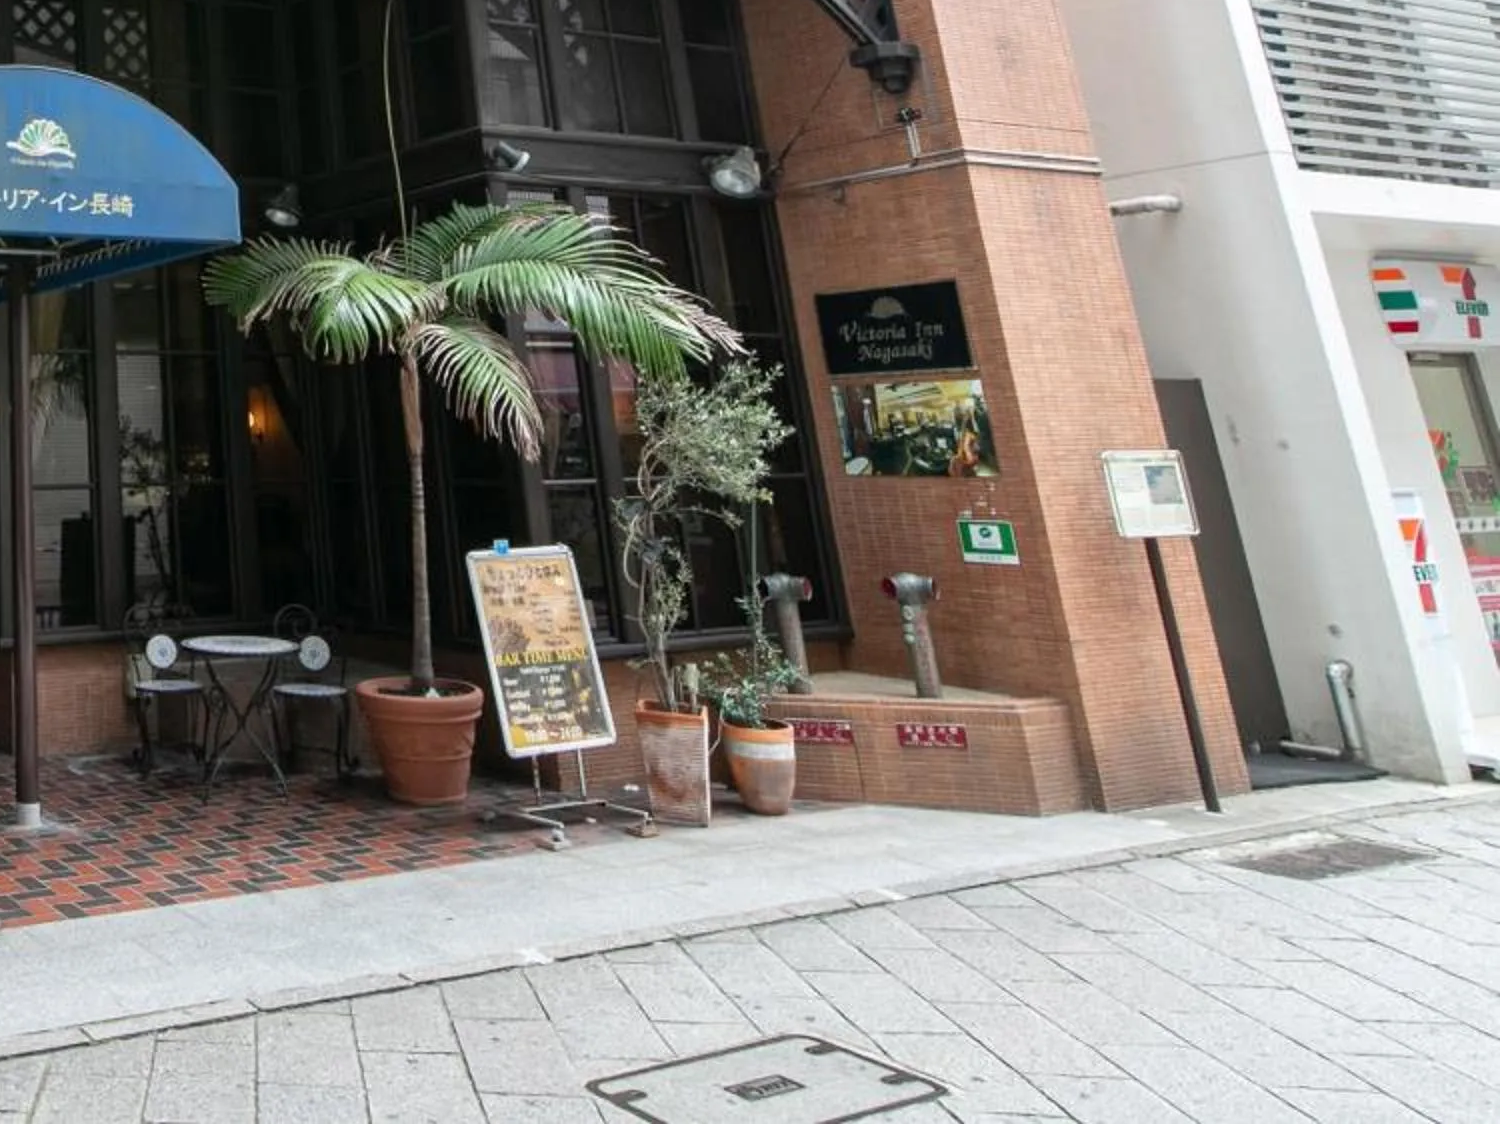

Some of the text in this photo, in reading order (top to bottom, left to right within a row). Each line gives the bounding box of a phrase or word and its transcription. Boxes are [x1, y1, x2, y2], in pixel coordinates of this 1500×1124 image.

[838, 319, 944, 343] Victoria Inn
[857, 338, 933, 364] Nagasaki
